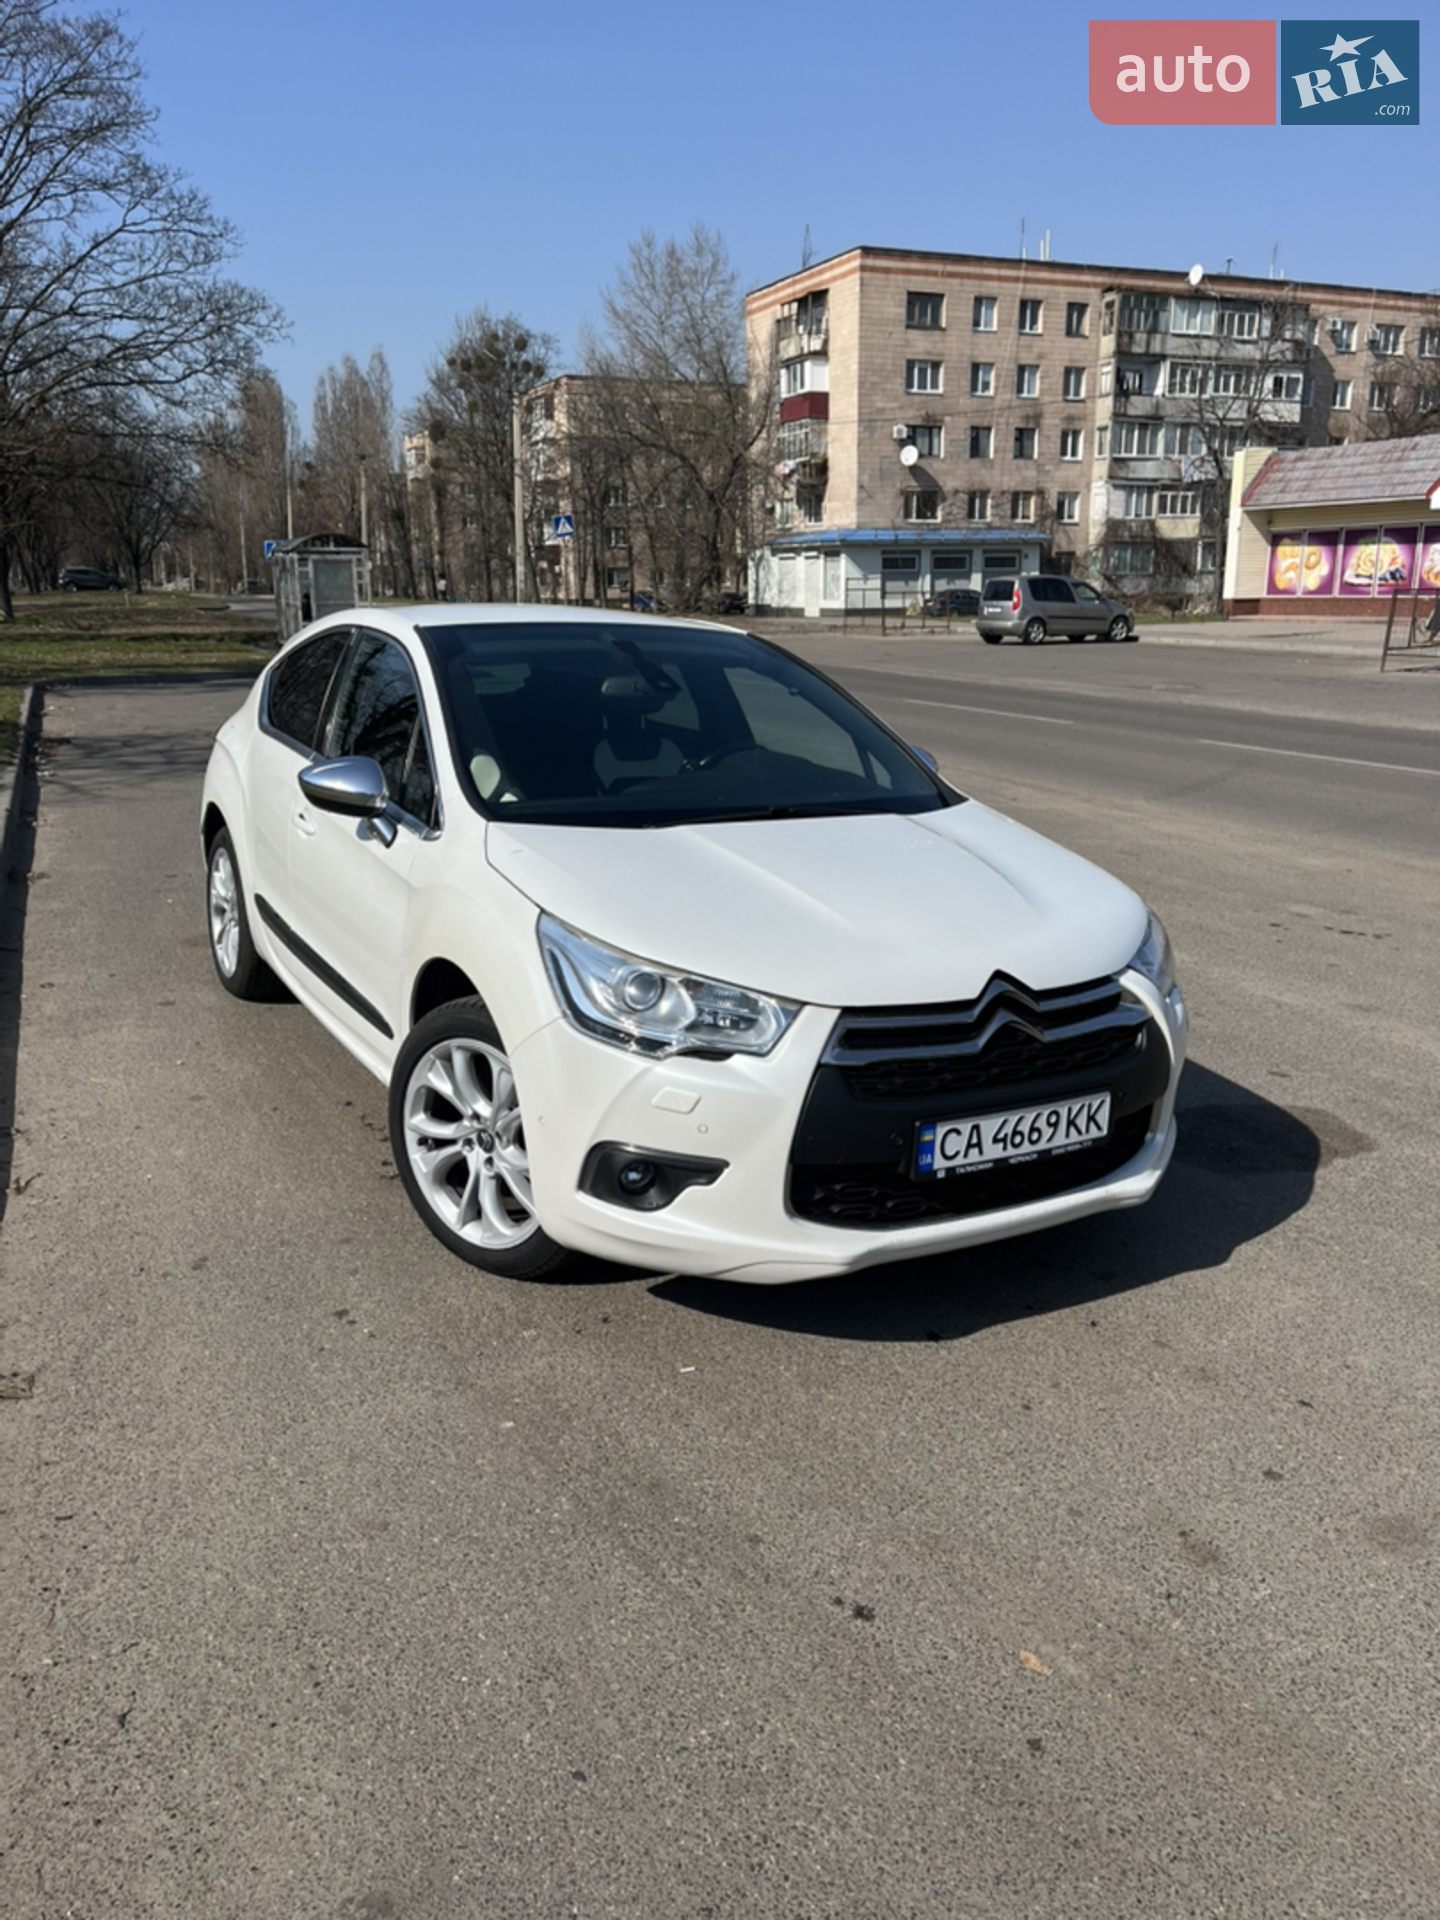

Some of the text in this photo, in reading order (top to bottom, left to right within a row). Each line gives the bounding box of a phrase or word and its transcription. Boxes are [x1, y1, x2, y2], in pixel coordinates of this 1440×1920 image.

[939, 1098, 1105, 1161] CA 4669 KK
[919, 1154, 932, 1165] UA
